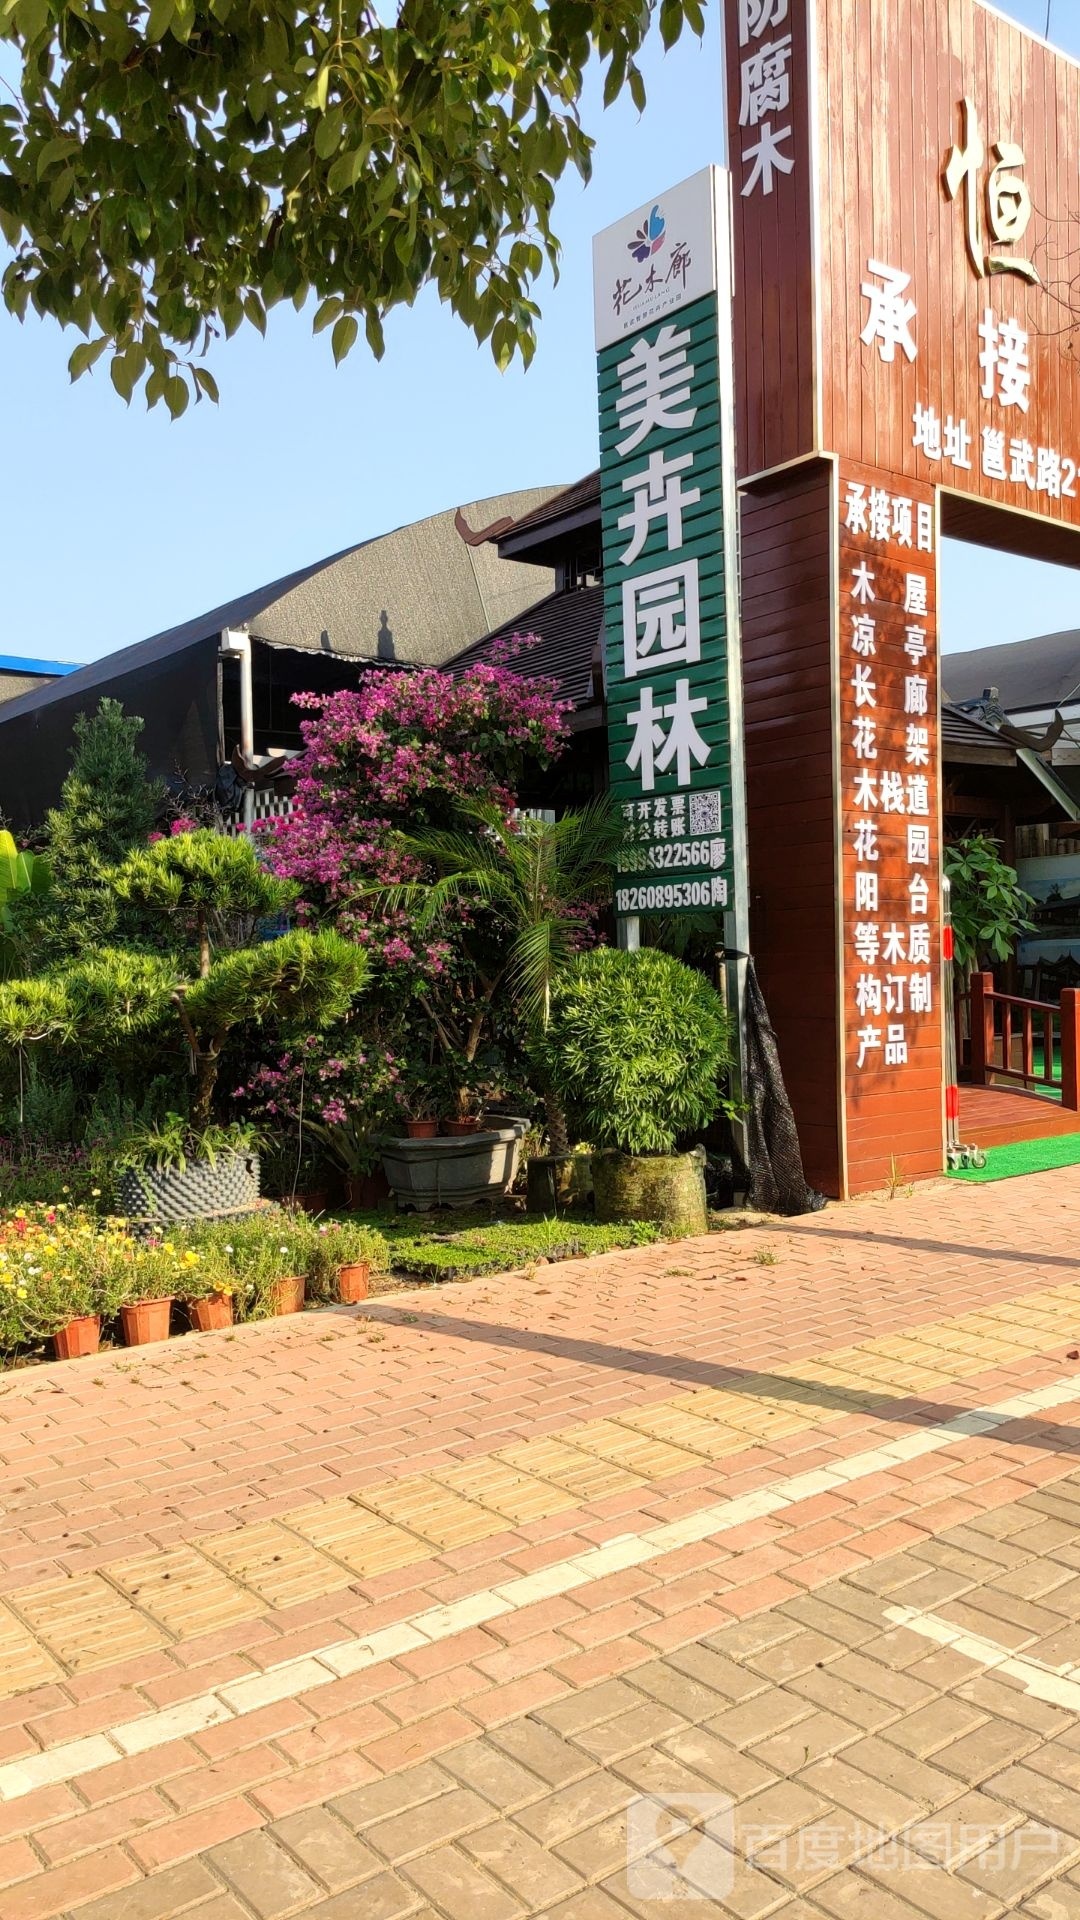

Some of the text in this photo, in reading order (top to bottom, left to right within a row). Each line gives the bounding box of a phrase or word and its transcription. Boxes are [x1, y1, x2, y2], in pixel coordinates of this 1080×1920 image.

[943, 96, 1040, 284] 恒
[613, 242, 691, 316] 花木廊
[982, 425, 1080, 499] 邕武路2
[845, 482, 934, 553] 承接项目
[614, 324, 712, 791] 美卉园林
[853, 768, 930, 815] 木栈道
[854, 922, 931, 965] 等木质
[856, 971, 932, 1017] 构订制
[856, 1024, 908, 1069] 产品
